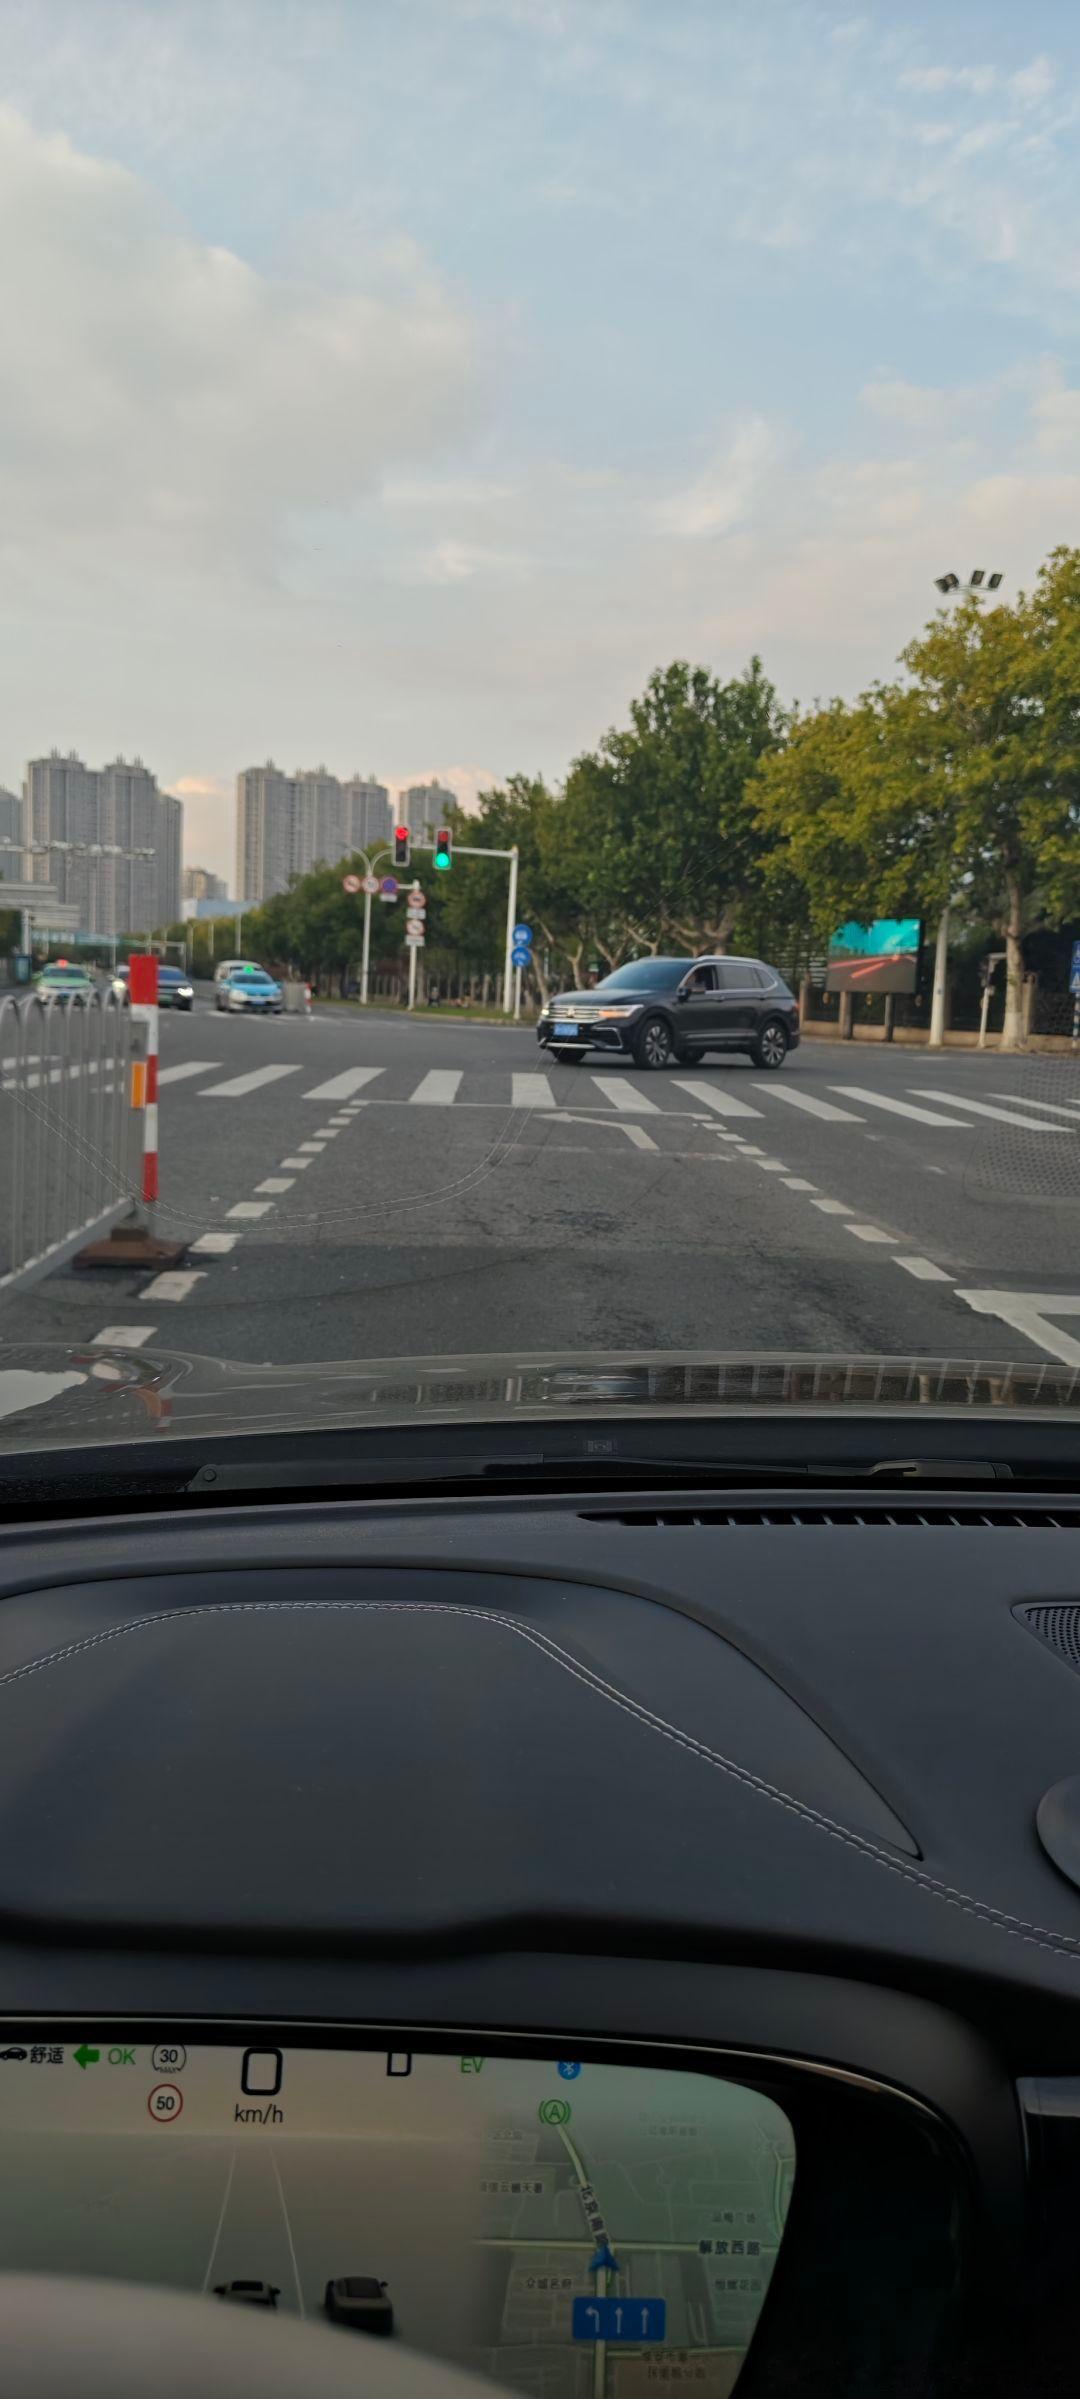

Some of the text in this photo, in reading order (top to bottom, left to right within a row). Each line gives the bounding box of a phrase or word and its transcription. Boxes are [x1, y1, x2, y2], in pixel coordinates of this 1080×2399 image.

[30, 2046, 64, 2064] 舒适
[107, 2048, 136, 2065] OK
[160, 2048, 178, 2063] 30
[460, 2055, 485, 2073] EV
[241, 2047, 283, 2096] 0
[156, 2096, 175, 2111] 50
[234, 2103, 283, 2125] km/h
